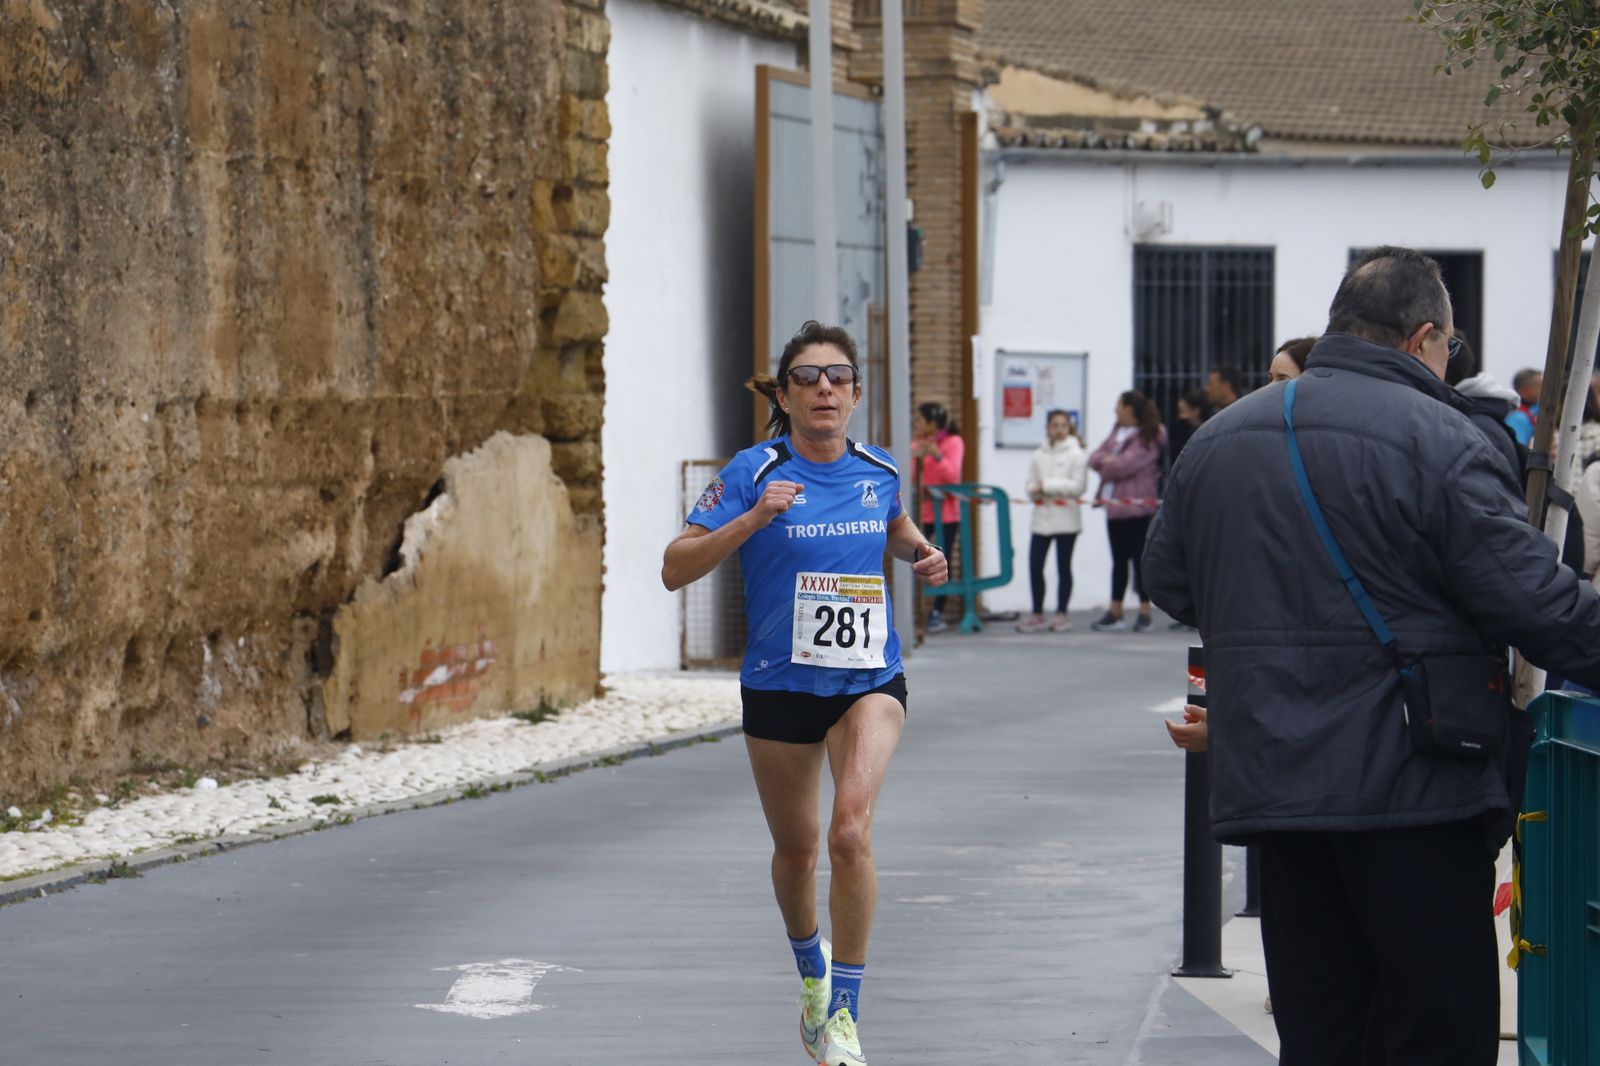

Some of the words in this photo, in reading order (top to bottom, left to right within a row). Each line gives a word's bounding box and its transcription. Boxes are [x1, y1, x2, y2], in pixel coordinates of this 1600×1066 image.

[785, 520, 886, 538] TROTASIERRA
[800, 575, 839, 592] XXXIX
[813, 605, 871, 649] 281
